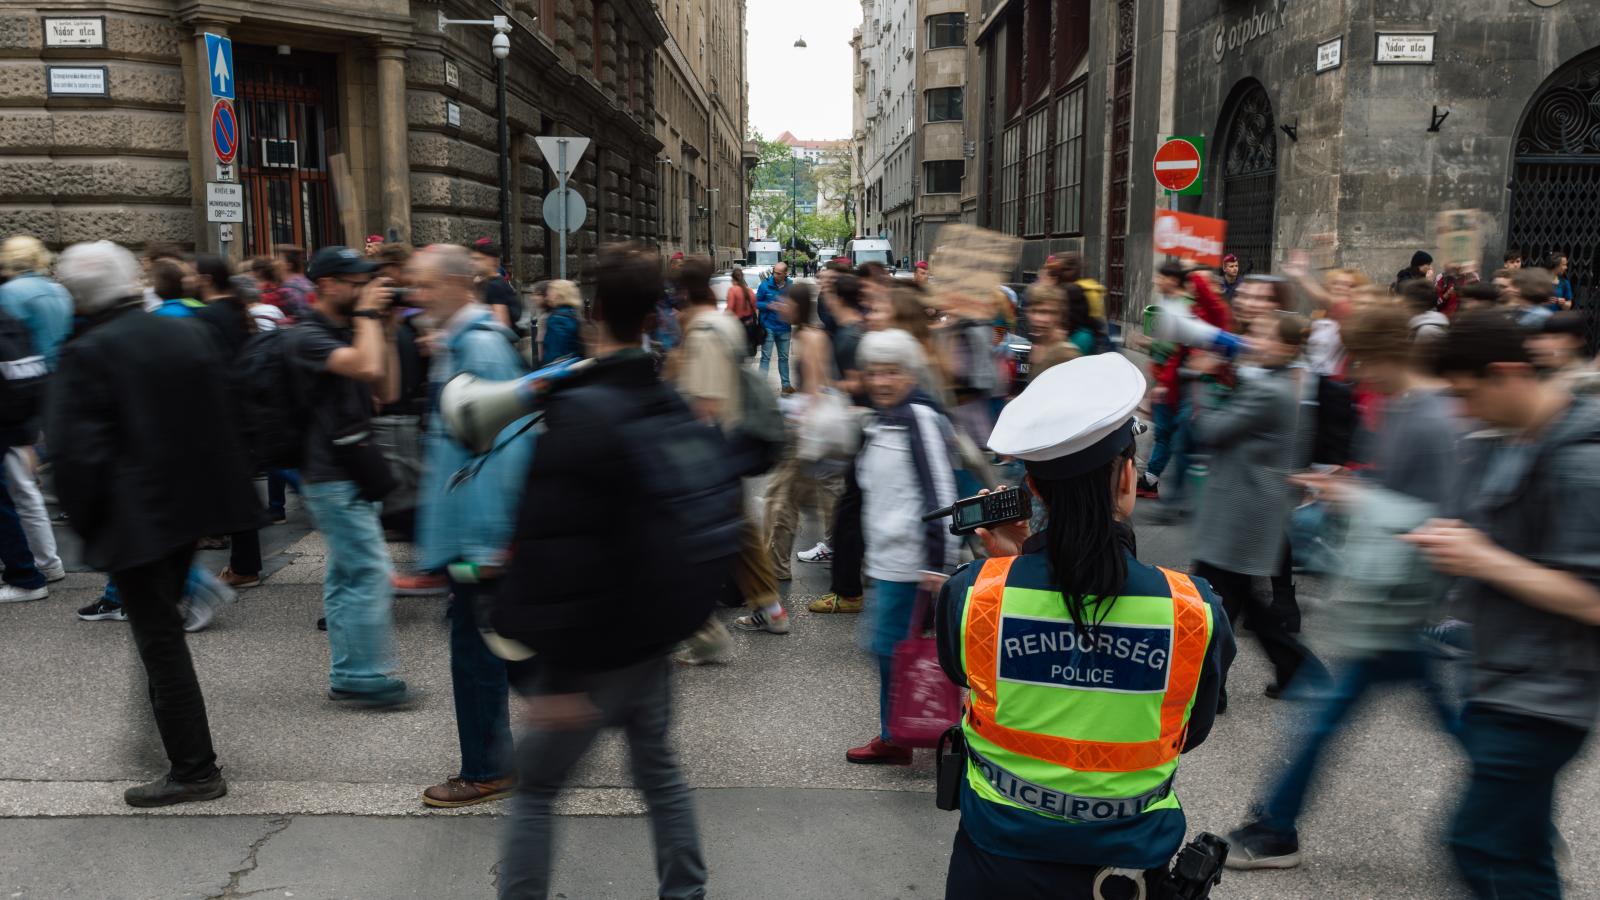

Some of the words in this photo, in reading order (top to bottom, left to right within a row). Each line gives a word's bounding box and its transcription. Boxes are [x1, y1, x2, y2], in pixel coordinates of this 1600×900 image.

[53, 25, 75, 36] Nádor
[79, 26, 96, 36] utca
[1385, 41, 1405, 52] Nádor
[1410, 42, 1426, 52] utca
[1051, 664, 1114, 684] POLICE
[975, 760, 1056, 812] OLICE
